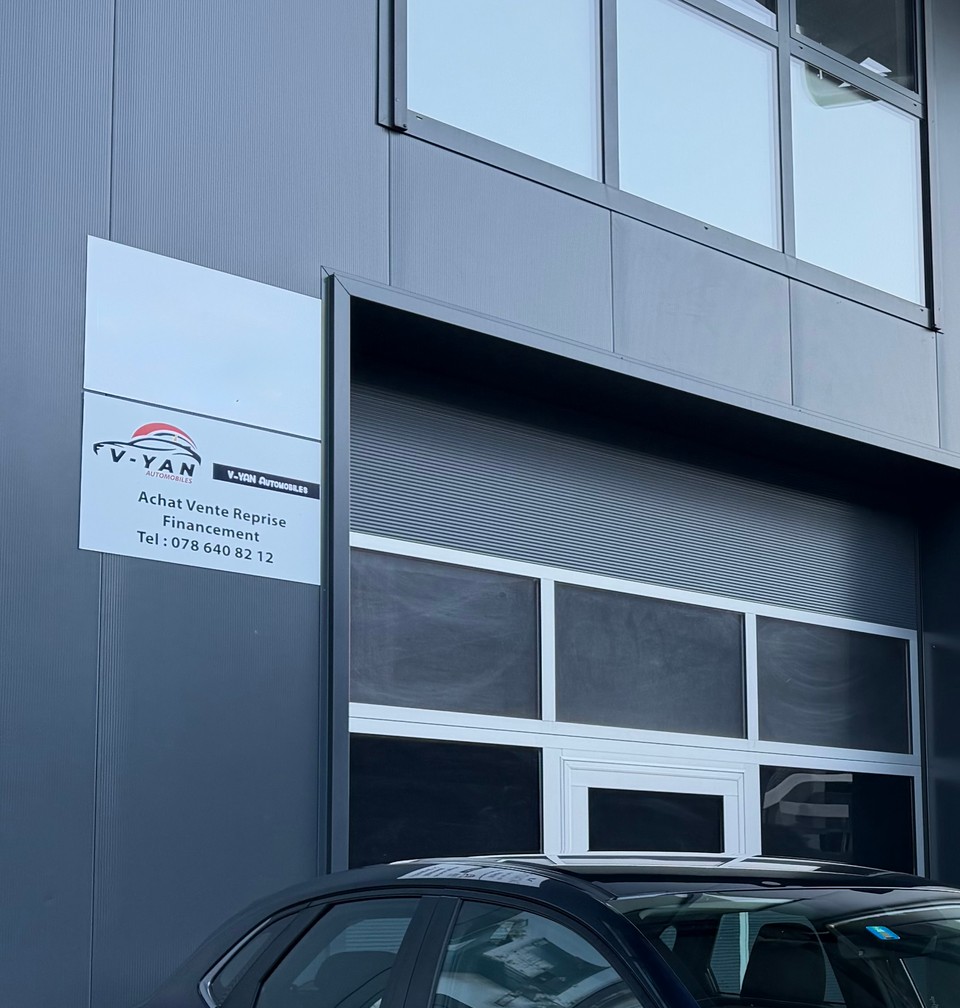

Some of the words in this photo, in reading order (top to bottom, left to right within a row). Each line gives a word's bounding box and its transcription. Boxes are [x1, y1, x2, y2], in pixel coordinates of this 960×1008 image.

[110, 448, 195, 477] V-YAN
[145, 470, 193, 484] AUTOMOBILES
[227, 470, 257, 484] V-YAN
[138, 491, 183, 510] Achat
[186, 499, 229, 518] Vente
[233, 507, 287, 528] Reprise
[162, 515, 260, 543] Financement
[136, 530, 159, 546] Tel
[171, 536, 200, 552] 078
[203, 542, 231, 557] 640
[234, 547, 252, 561] 82
[257, 550, 274, 564] 12
